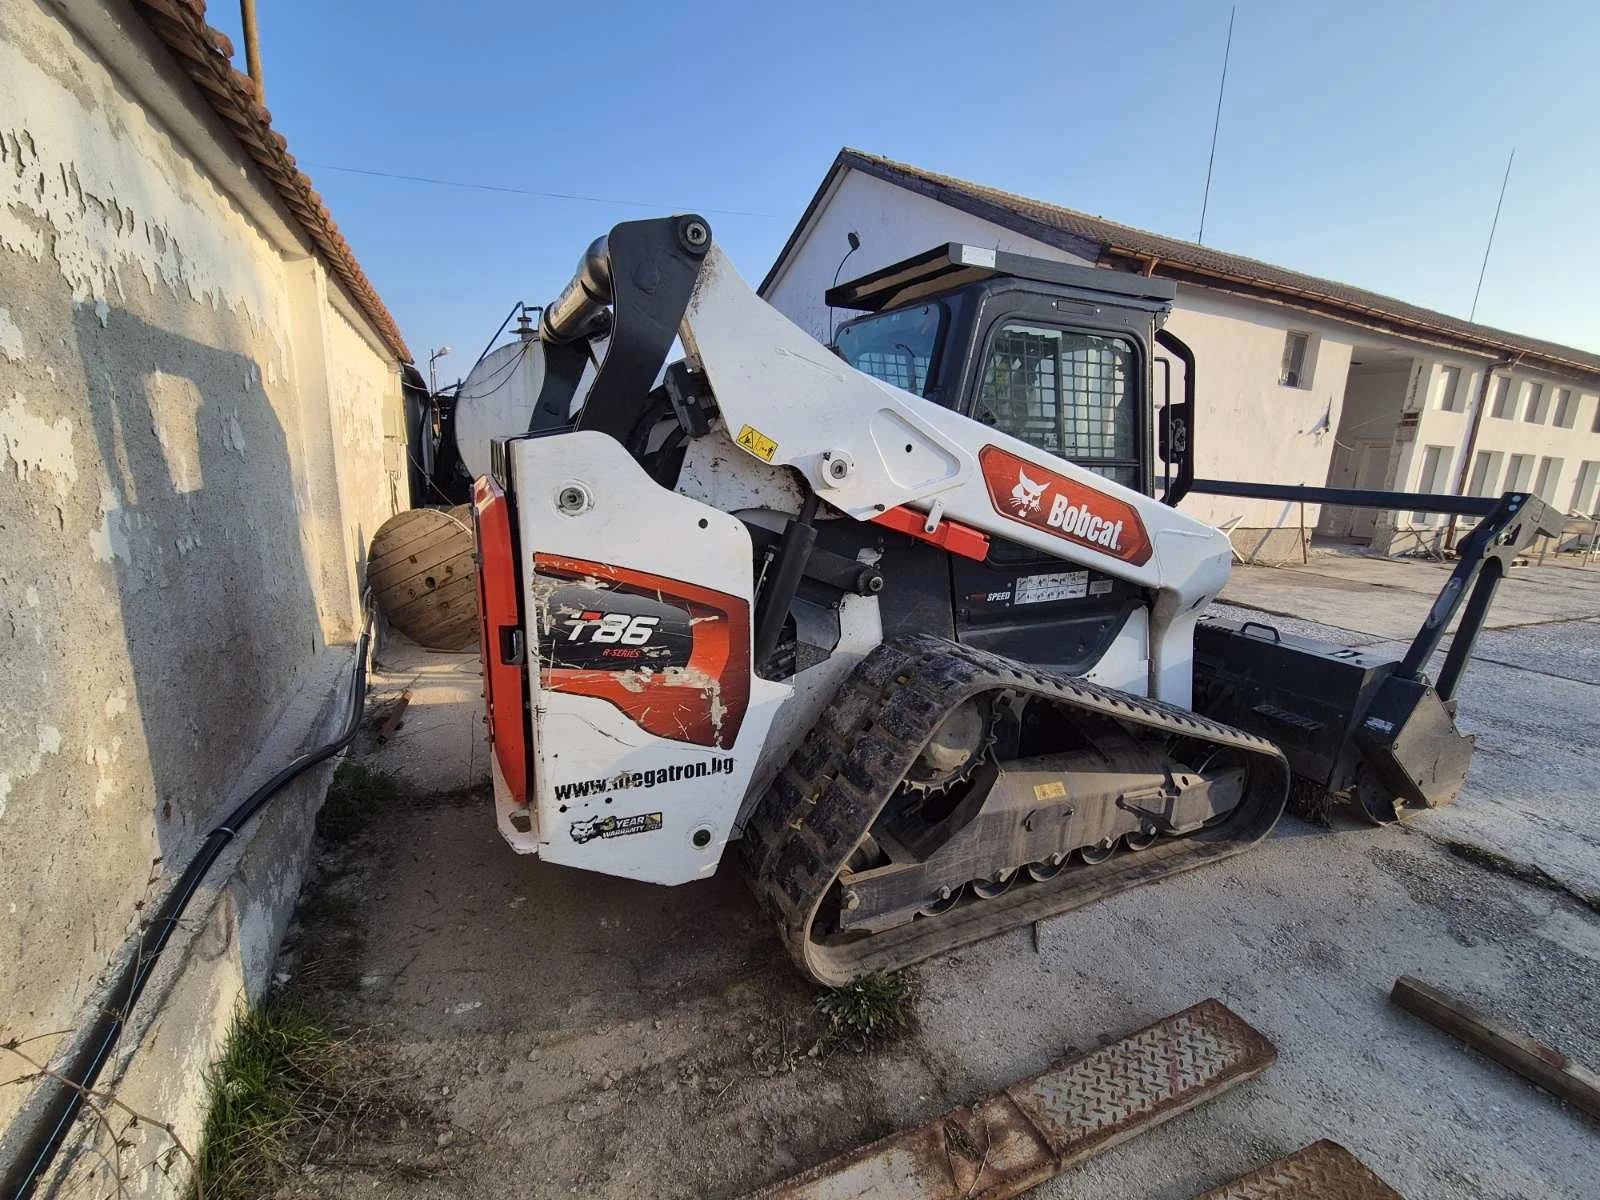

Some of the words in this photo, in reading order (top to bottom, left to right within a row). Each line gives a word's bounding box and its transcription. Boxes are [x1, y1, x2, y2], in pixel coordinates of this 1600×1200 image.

[1047, 493, 1123, 550] Bobcat
[987, 592, 1011, 602] SPEED
[563, 610, 660, 646] T86
[602, 648, 641, 658] R-SERIES
[615, 816, 645, 829] YEAR
[602, 826, 645, 839] WARRANTY
